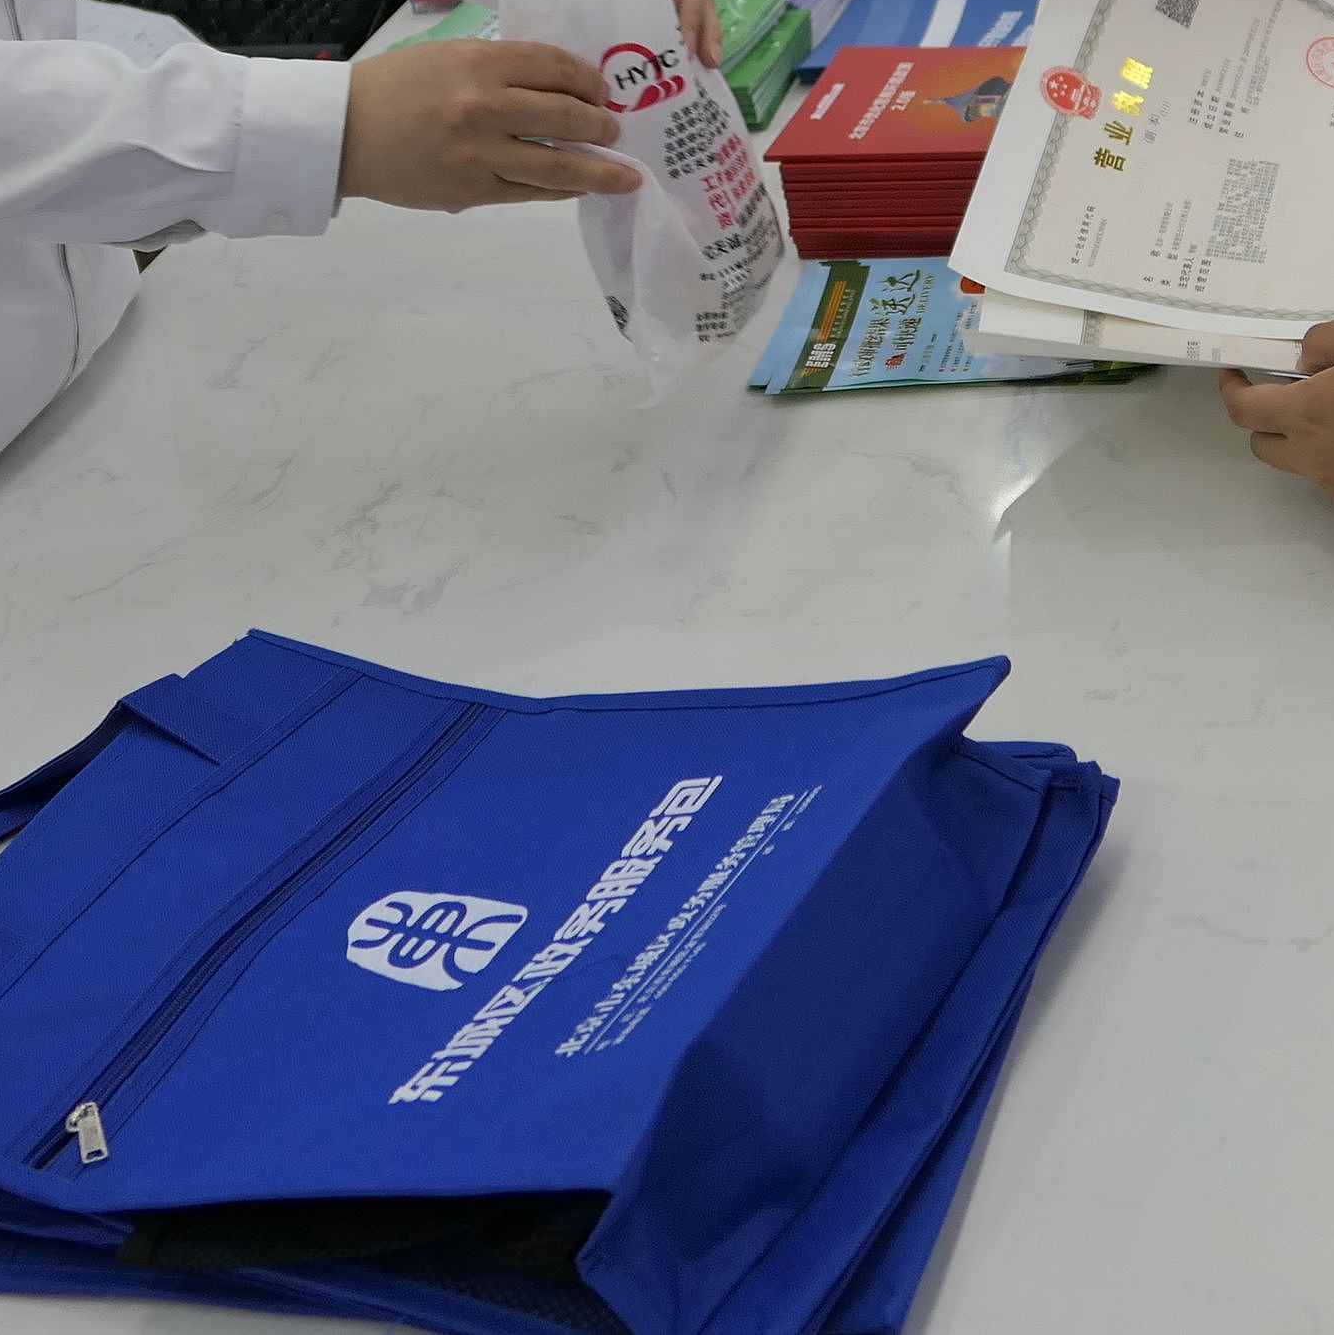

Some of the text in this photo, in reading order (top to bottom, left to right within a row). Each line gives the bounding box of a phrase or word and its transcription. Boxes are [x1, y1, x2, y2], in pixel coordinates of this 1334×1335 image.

[1094, 58, 1154, 172] 营业执照
[388, 775, 723, 1105] 东城区政务服务包
